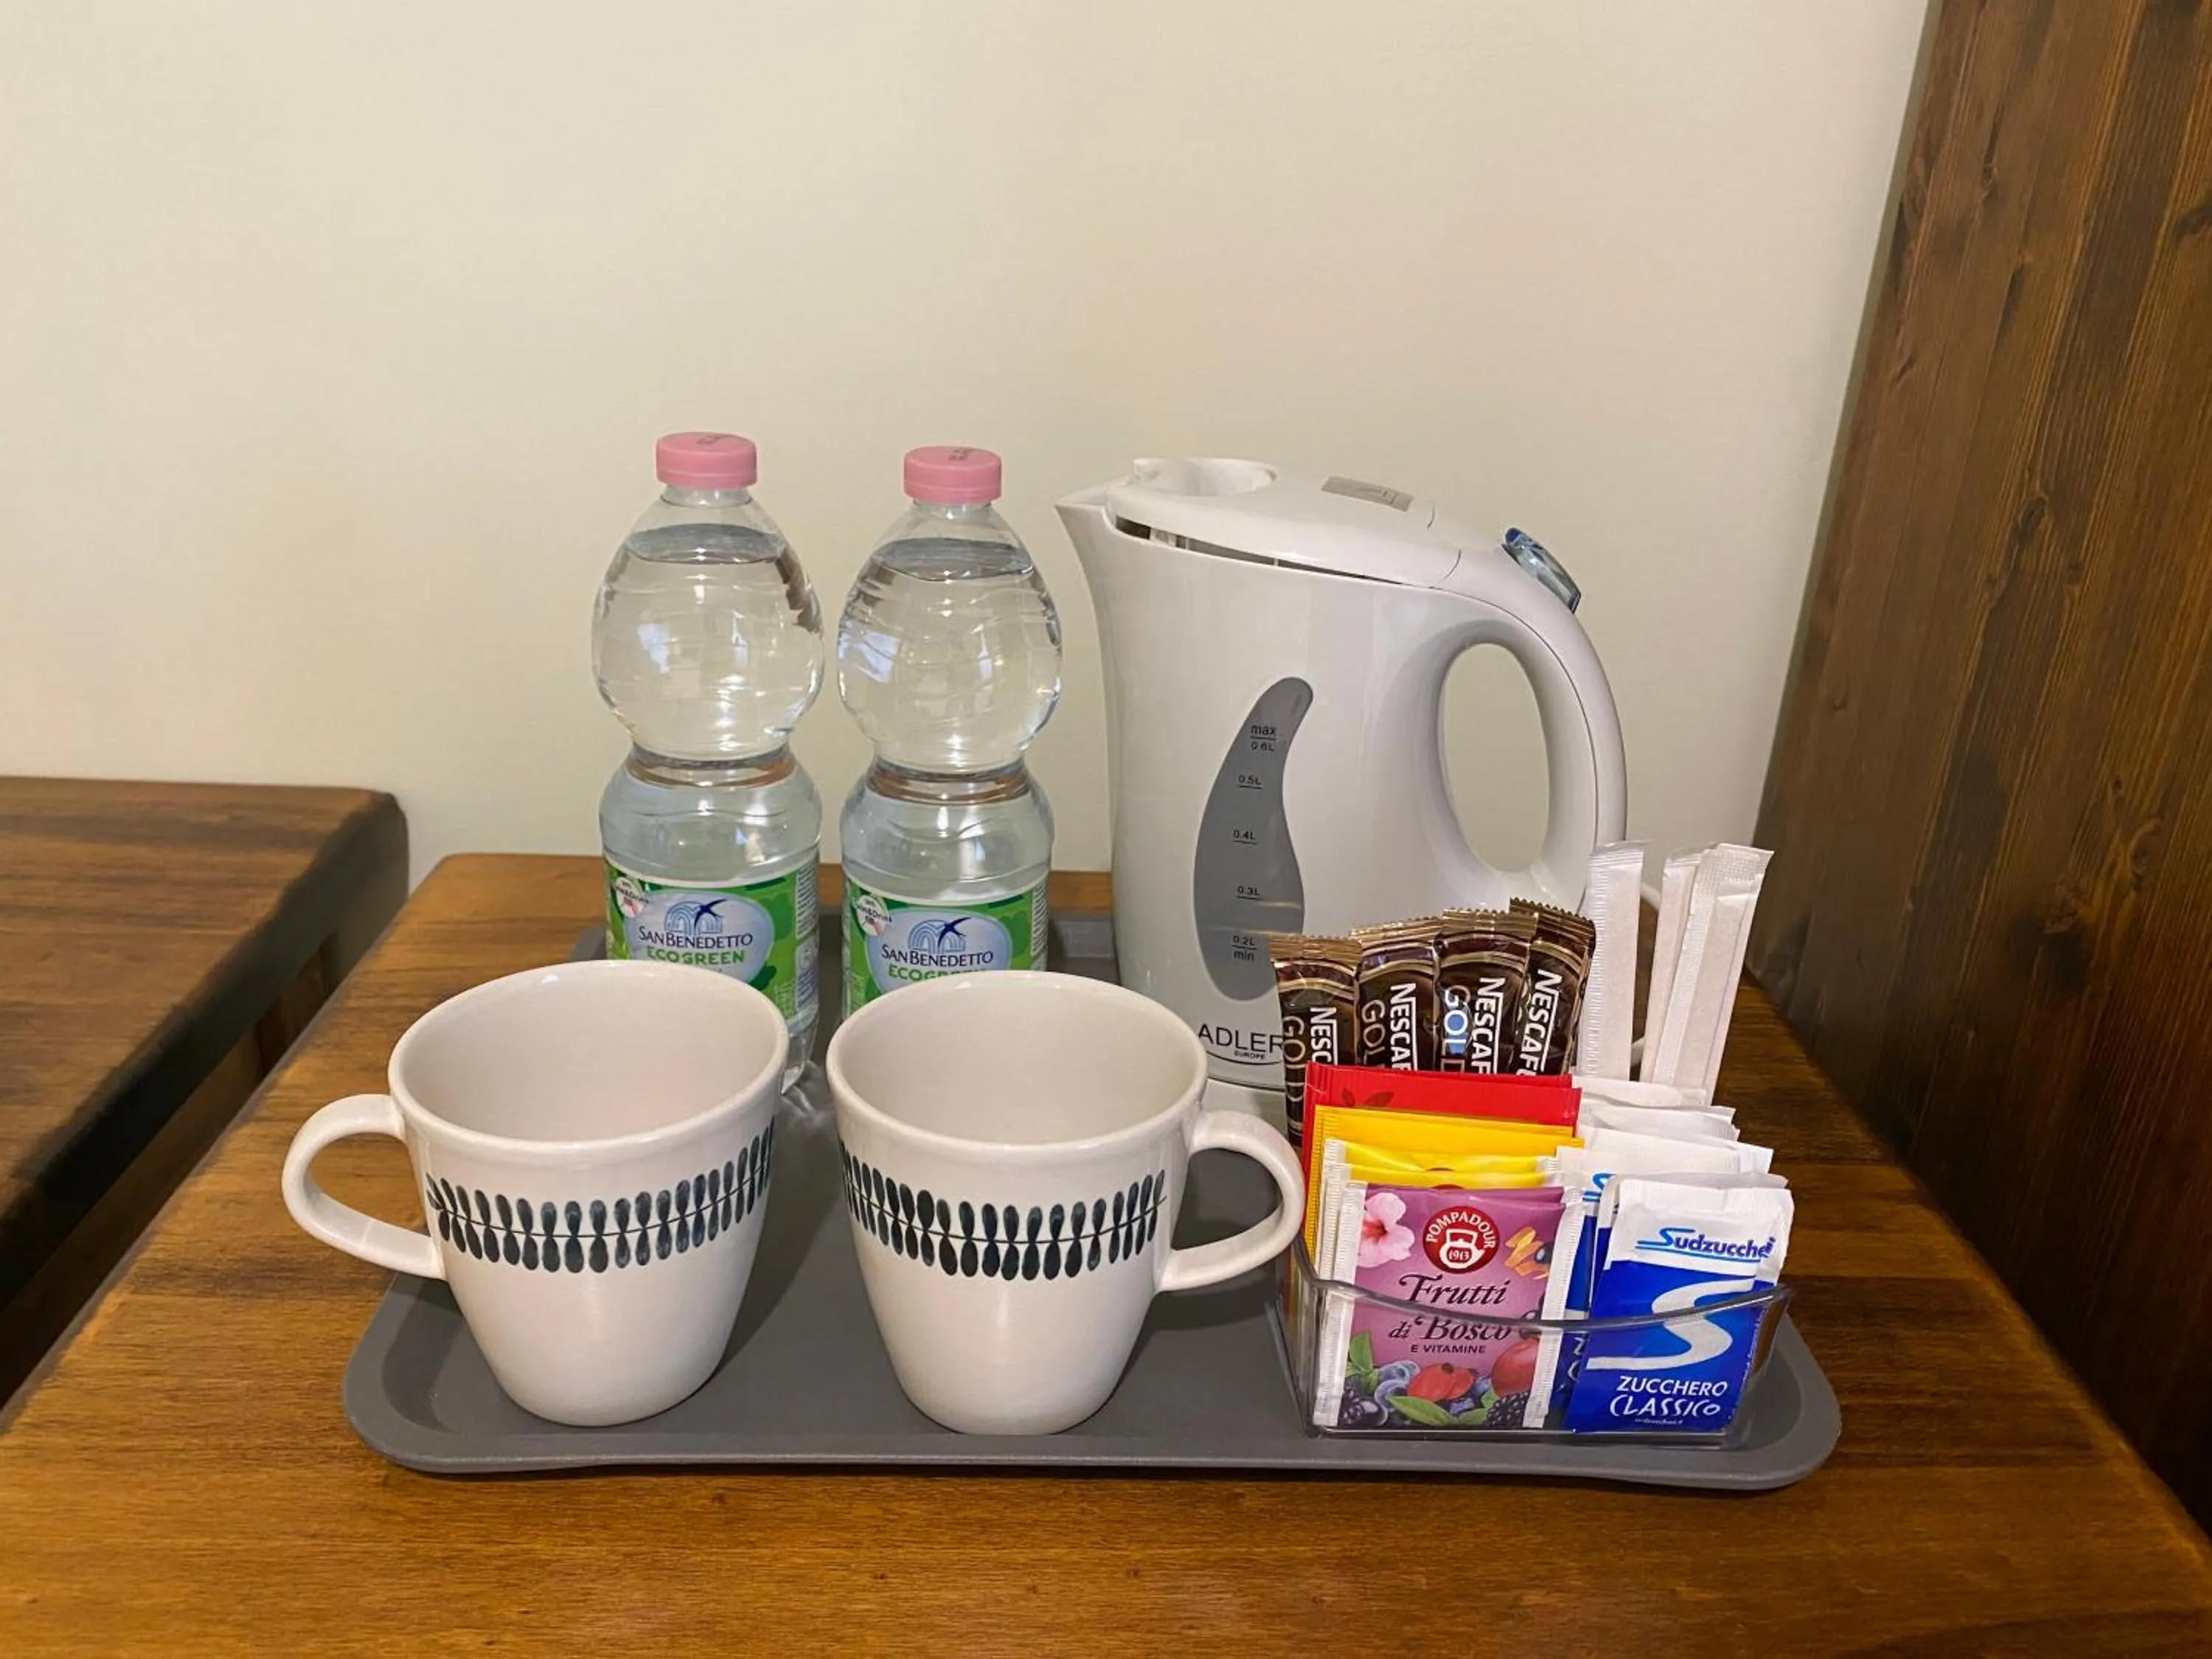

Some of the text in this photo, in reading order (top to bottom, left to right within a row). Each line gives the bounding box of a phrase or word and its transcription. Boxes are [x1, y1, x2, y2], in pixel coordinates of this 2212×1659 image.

[1251, 725, 1276, 736] max
[647, 945, 745, 965] ECOGREEN
[1234, 951, 1254, 961] min
[1198, 1023, 1283, 1053] ADLER
[1310, 1007, 1338, 1065] NESC
[1362, 999, 1385, 1067] GOL
[1471, 977, 1506, 1074] NESCAF
[1234, 1049, 1266, 1060] EUROPE
[1426, 1211, 1496, 1248] POMPADOUR
[1399, 1274, 1511, 1304] Frutti
[1388, 1315, 1512, 1340] di Bosco
[1411, 1344, 1486, 1354] E VITAMINE
[1616, 1375, 1728, 1397] ZUCCHERO
